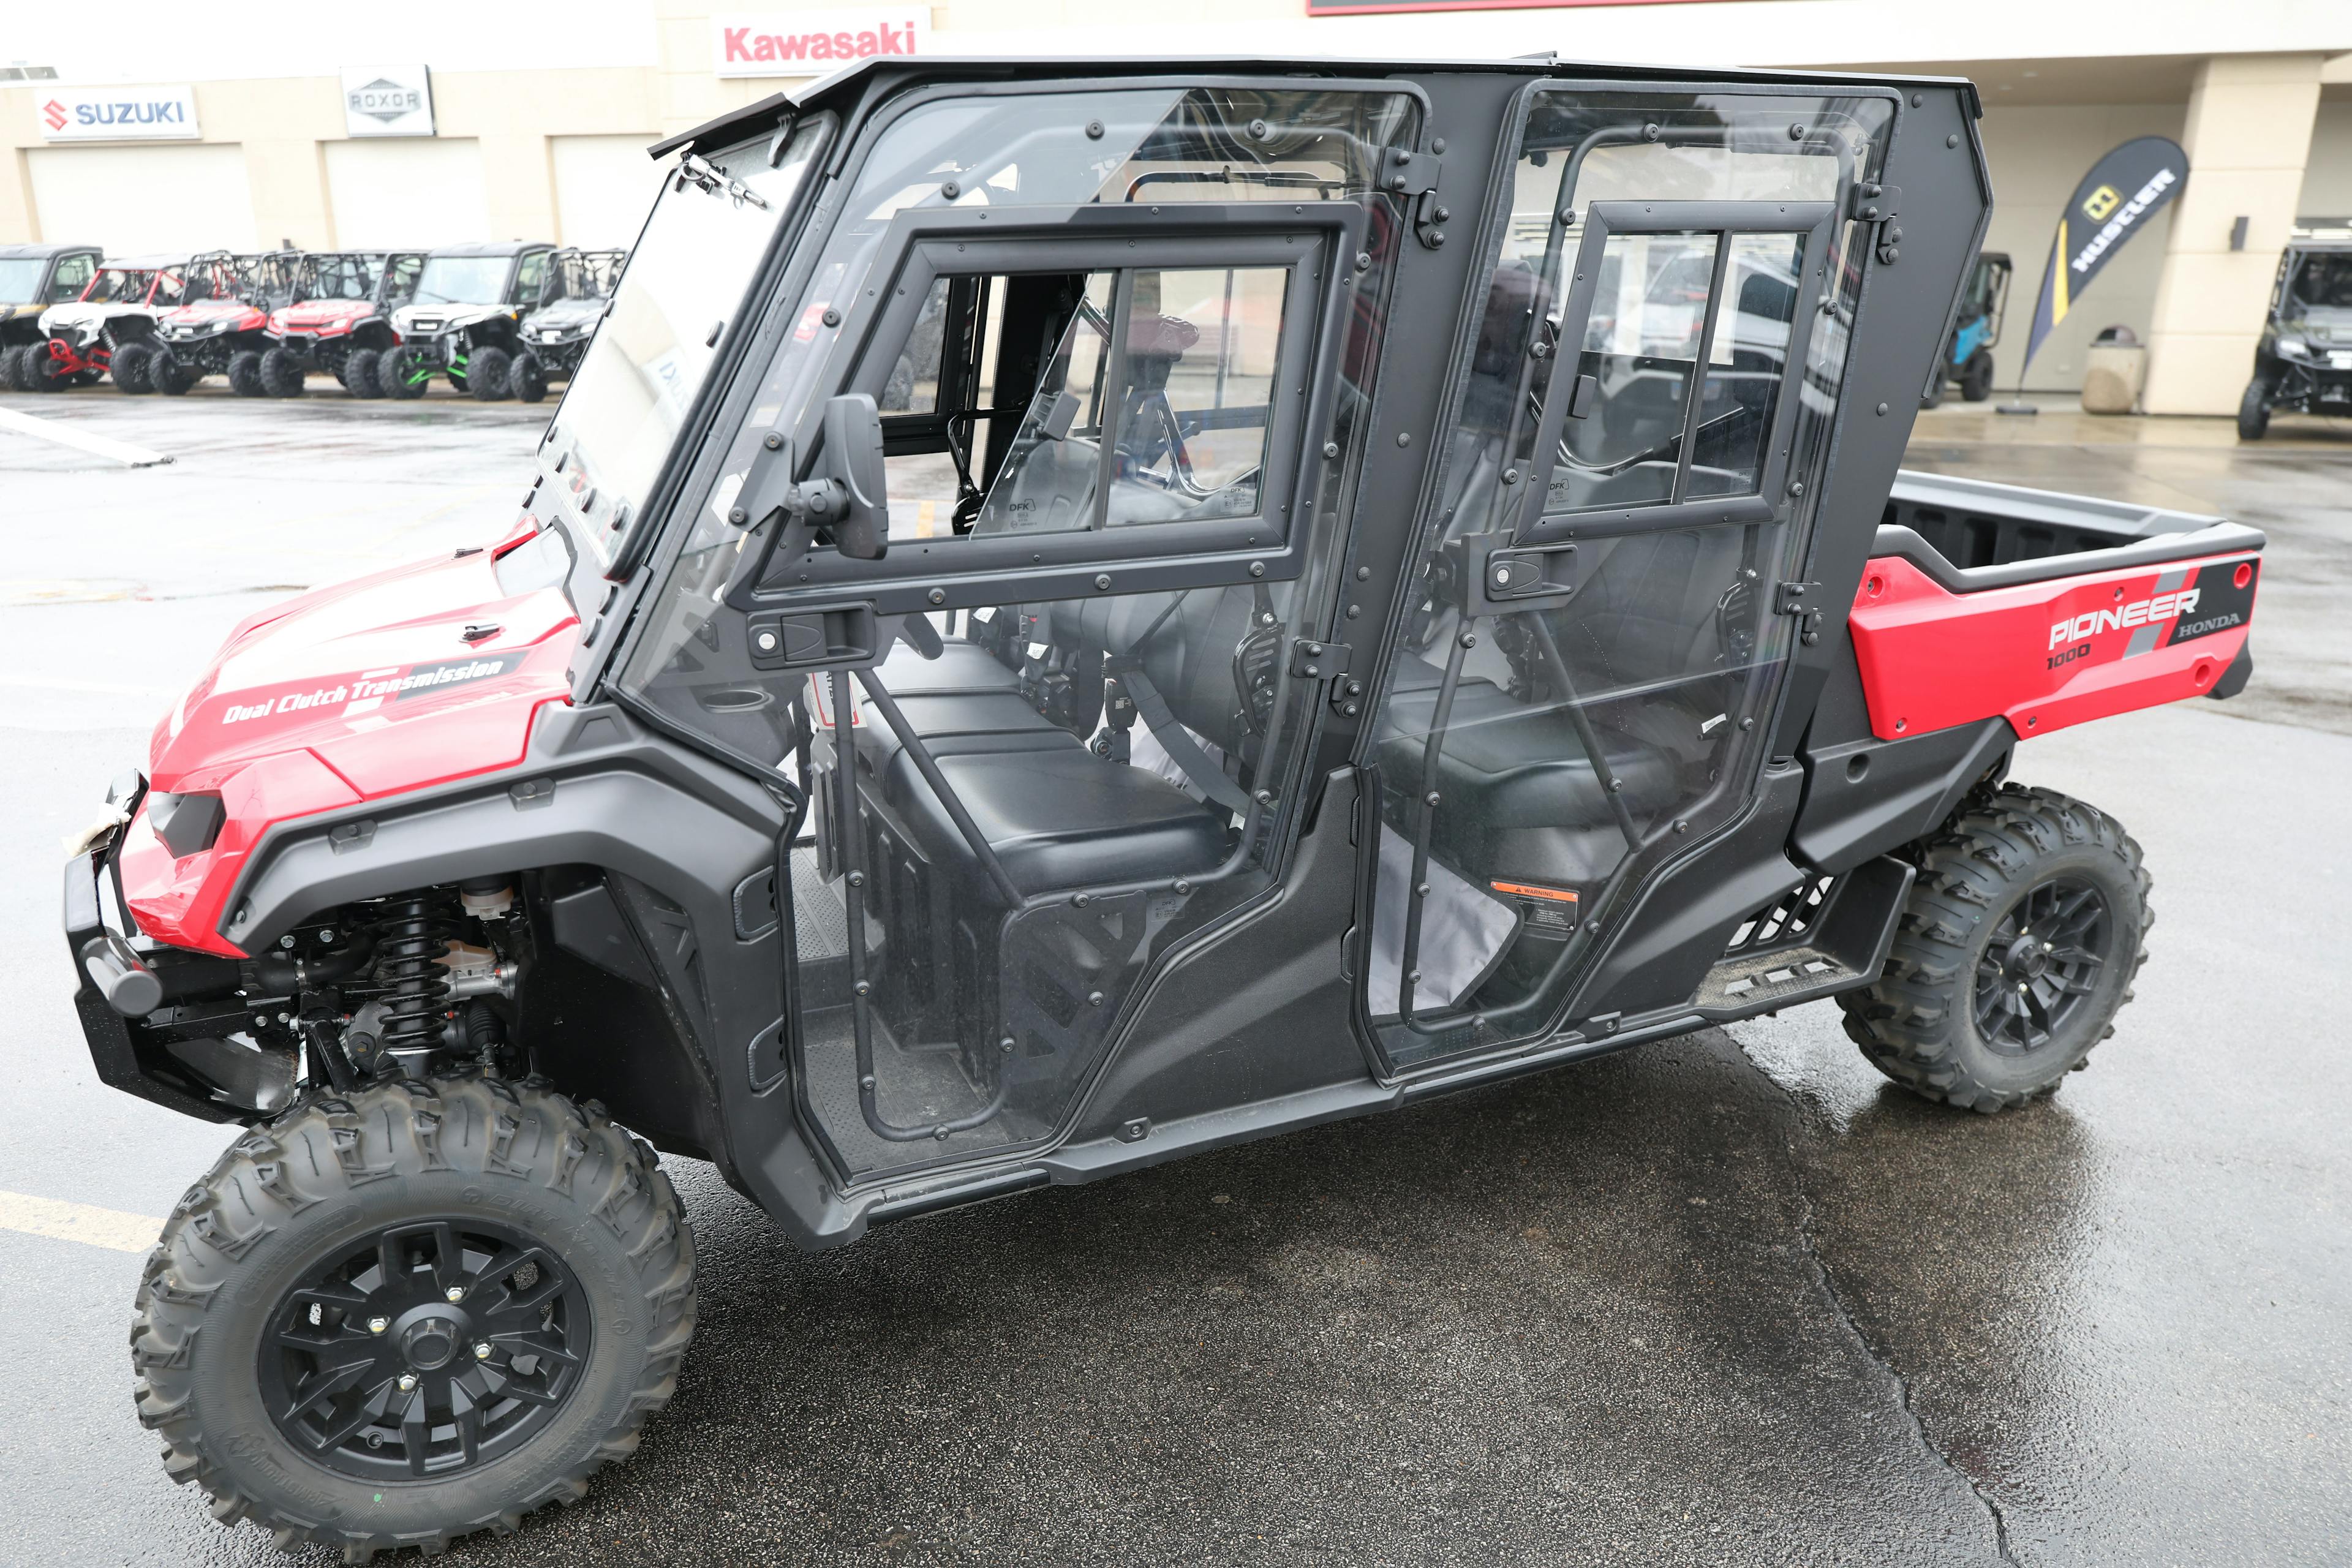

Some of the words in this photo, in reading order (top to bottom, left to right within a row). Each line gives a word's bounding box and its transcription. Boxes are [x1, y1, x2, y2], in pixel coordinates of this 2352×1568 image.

[725, 21, 915, 62] Kawasaki
[75, 101, 185, 126] SUZUKI
[351, 93, 418, 108] ROXOR
[2071, 167, 2176, 273] HUSTLER
[1009, 502, 1029, 511] DFK
[2048, 588, 2201, 650] PIONEER
[2178, 612, 2241, 638] HONDA
[2047, 644, 2091, 670] 1000
[222, 699, 275, 725] Dual
[276, 685, 347, 714] Clutch
[352, 660, 504, 699] Transmission
[1524, 888, 1553, 897] WARNING
